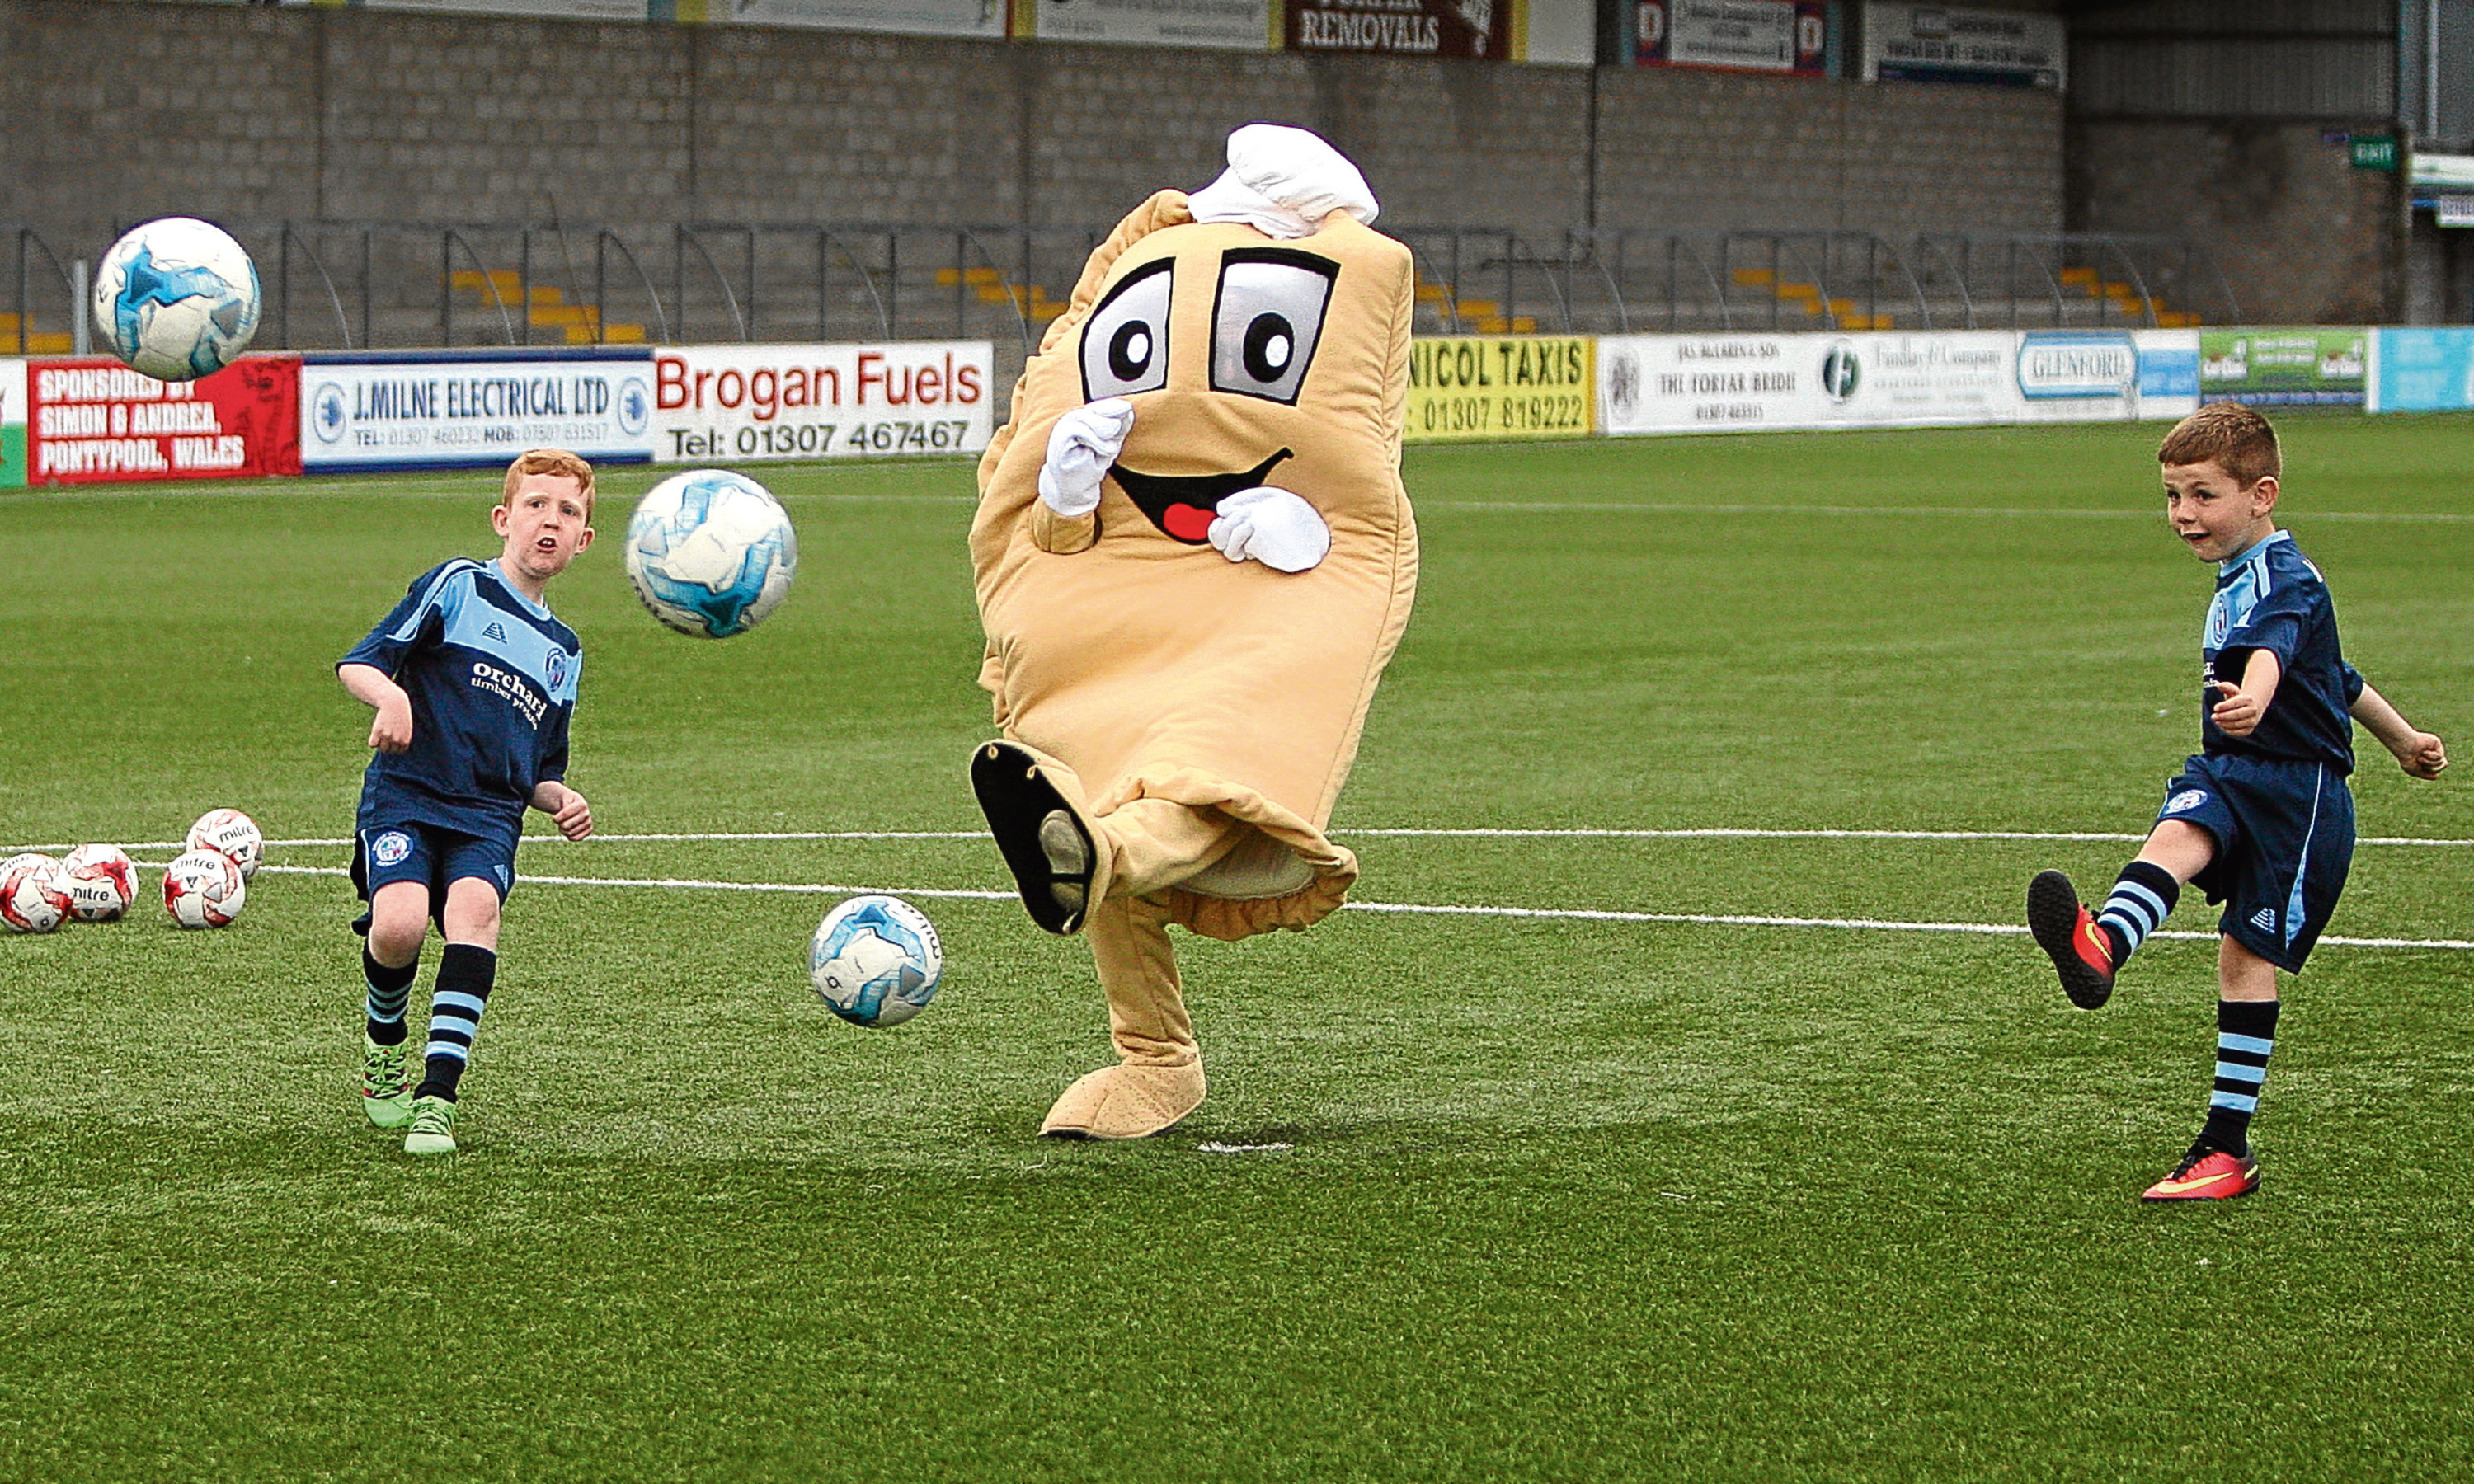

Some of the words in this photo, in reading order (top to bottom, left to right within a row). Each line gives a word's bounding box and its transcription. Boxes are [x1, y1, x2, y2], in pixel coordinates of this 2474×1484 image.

[1300, 9, 1439, 52] REMOVALS
[2356, 143, 2392, 161] EXIT
[1409, 340, 1491, 387] NICOL
[1499, 340, 1583, 386] TAXIS
[2034, 351, 2128, 378] GLENFORD
[354, 377, 440, 420] J.MILNE
[446, 375, 567, 418] ELECTRICAL
[574, 374, 609, 416] LTD
[656, 355, 841, 421] Brogan
[858, 352, 981, 406] Fuels
[1661, 373, 1684, 393] THE
[39, 404, 108, 435] SIMON
[110, 403, 129, 435] &
[131, 401, 223, 436] ANDREA,
[1424, 397, 1490, 431] 01307
[1503, 395, 1583, 429] 819222
[39, 437, 170, 474] PONTYPOOL,
[172, 434, 246, 470] WALES
[668, 427, 726, 458] Tel:
[736, 423, 838, 455] 01307
[848, 420, 970, 452] 467467
[219, 824, 255, 844] mitre
[175, 857, 216, 871] mitre
